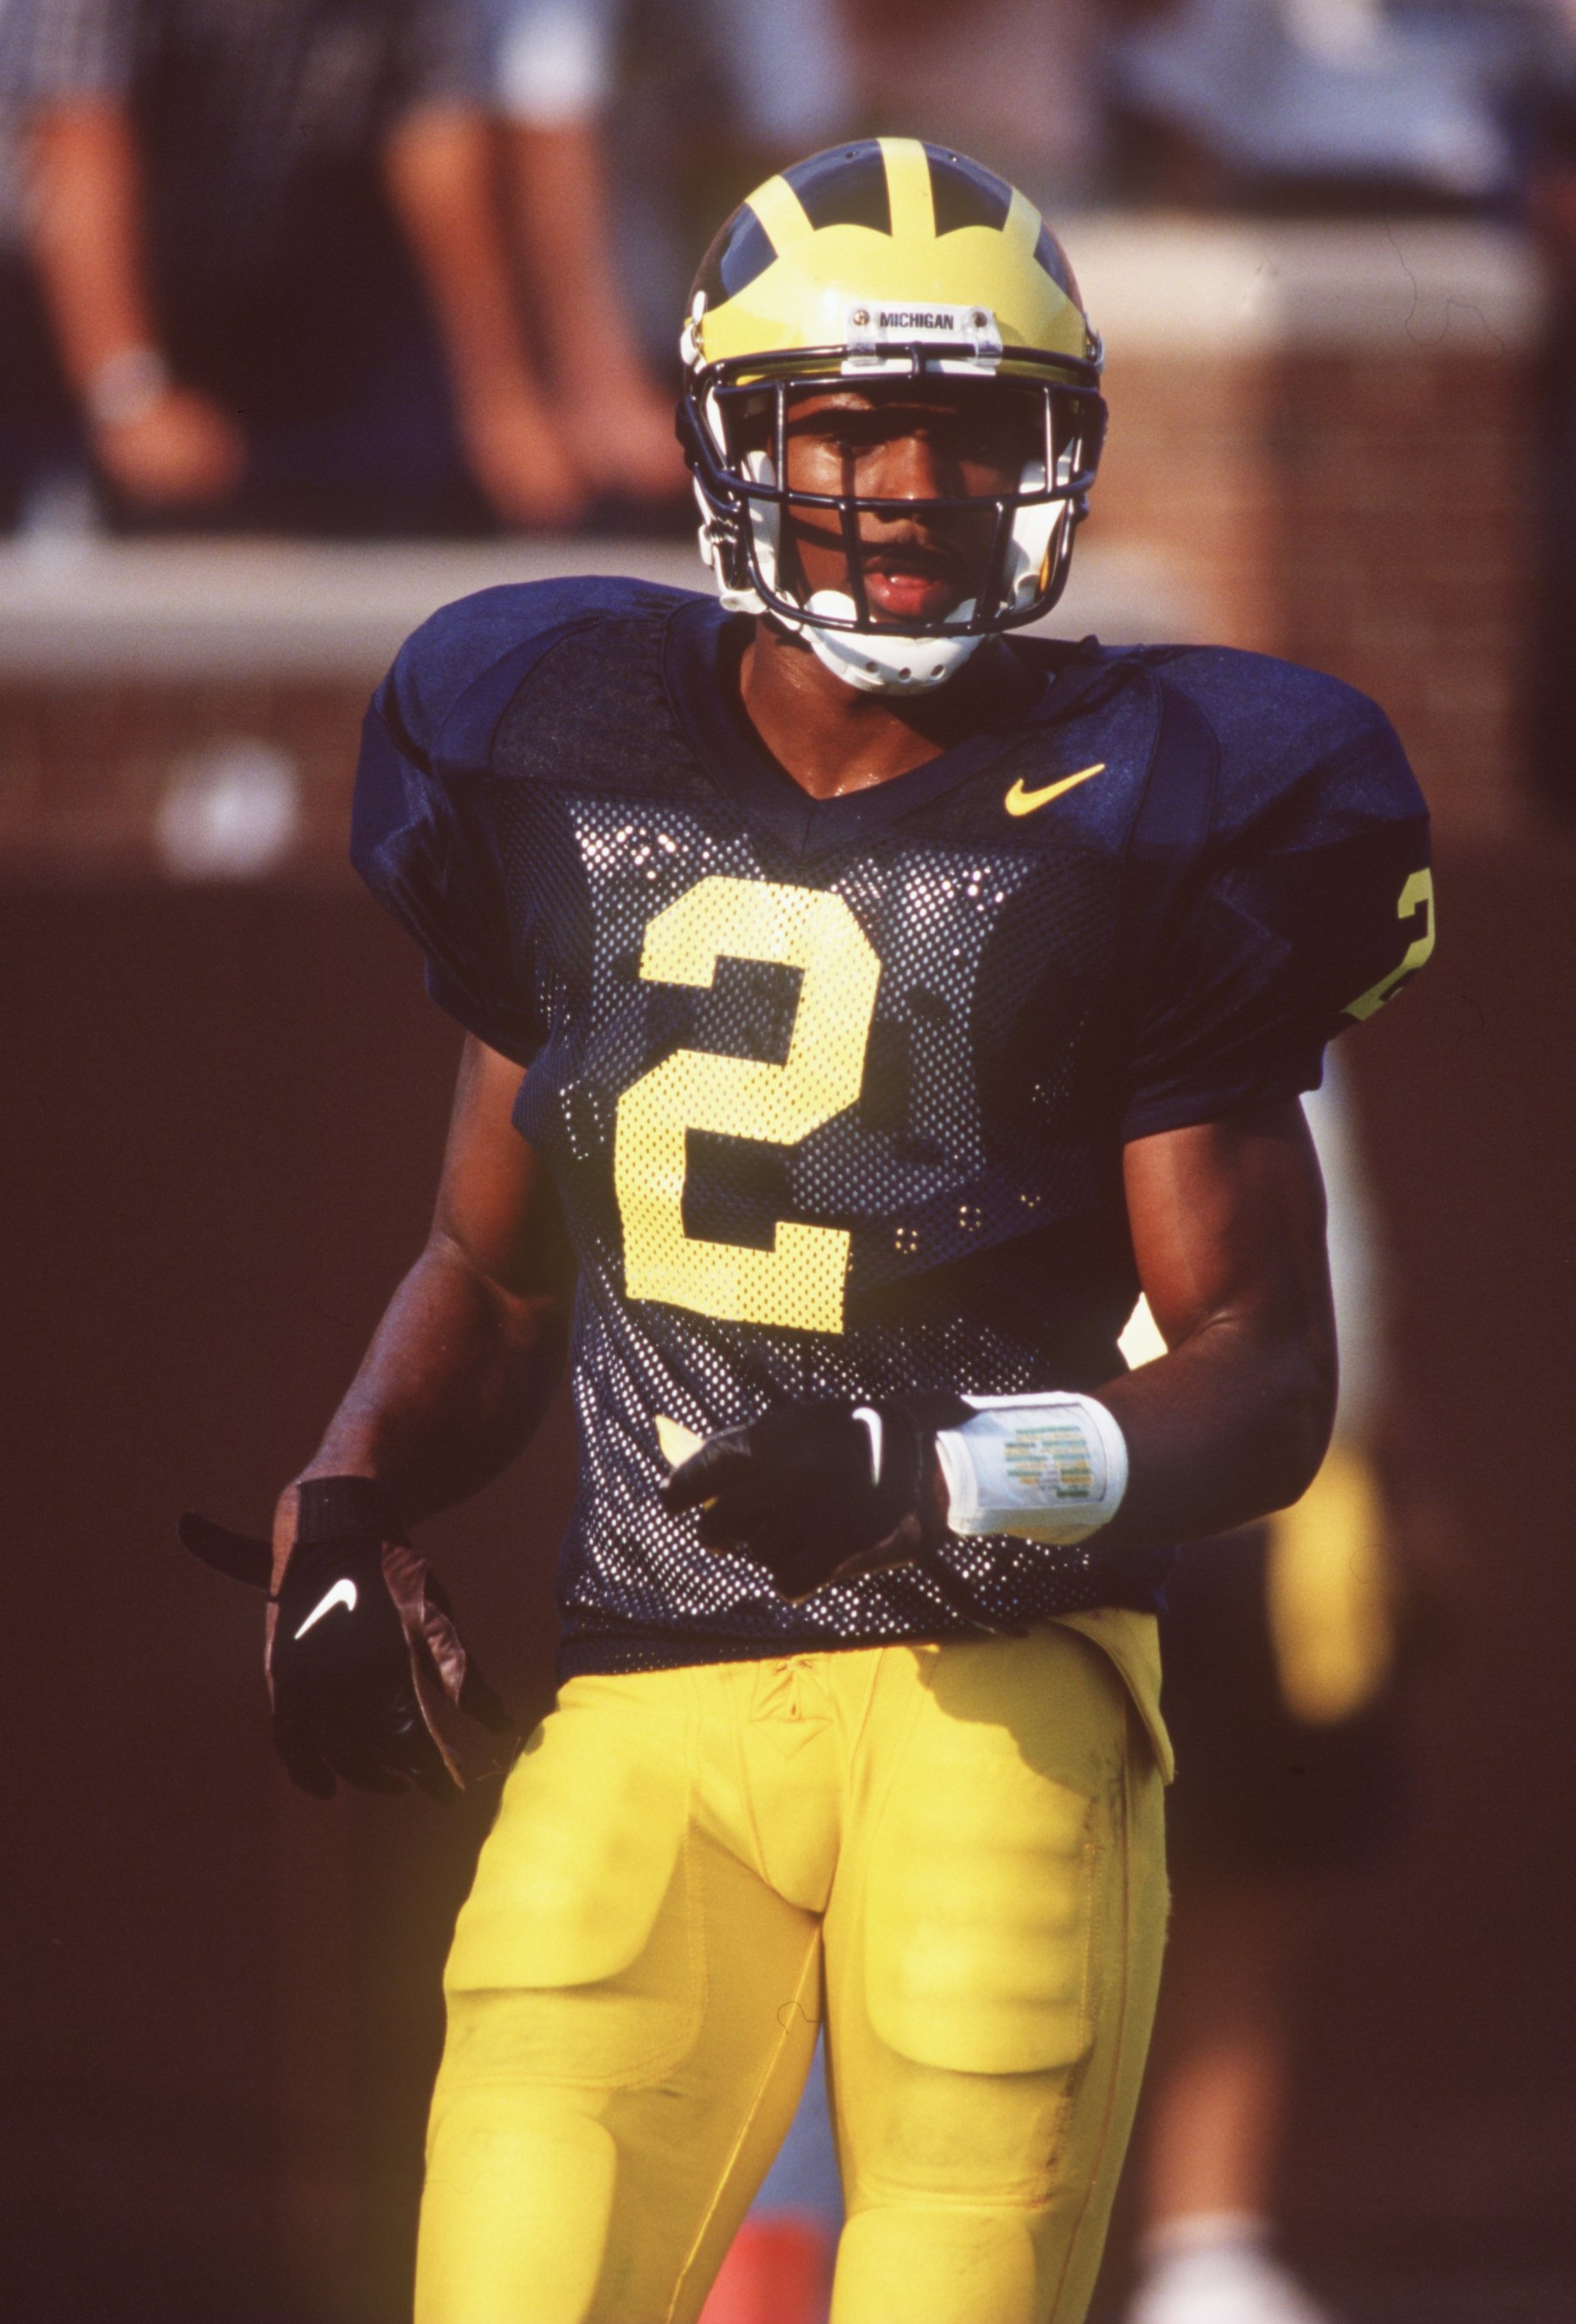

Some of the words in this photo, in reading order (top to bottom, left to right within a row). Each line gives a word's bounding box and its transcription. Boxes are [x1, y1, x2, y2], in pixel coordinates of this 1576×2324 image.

[880, 313, 954, 330] MICHIGAN
[1340, 867, 1436, 1021] 2
[614, 875, 881, 1334] 2
